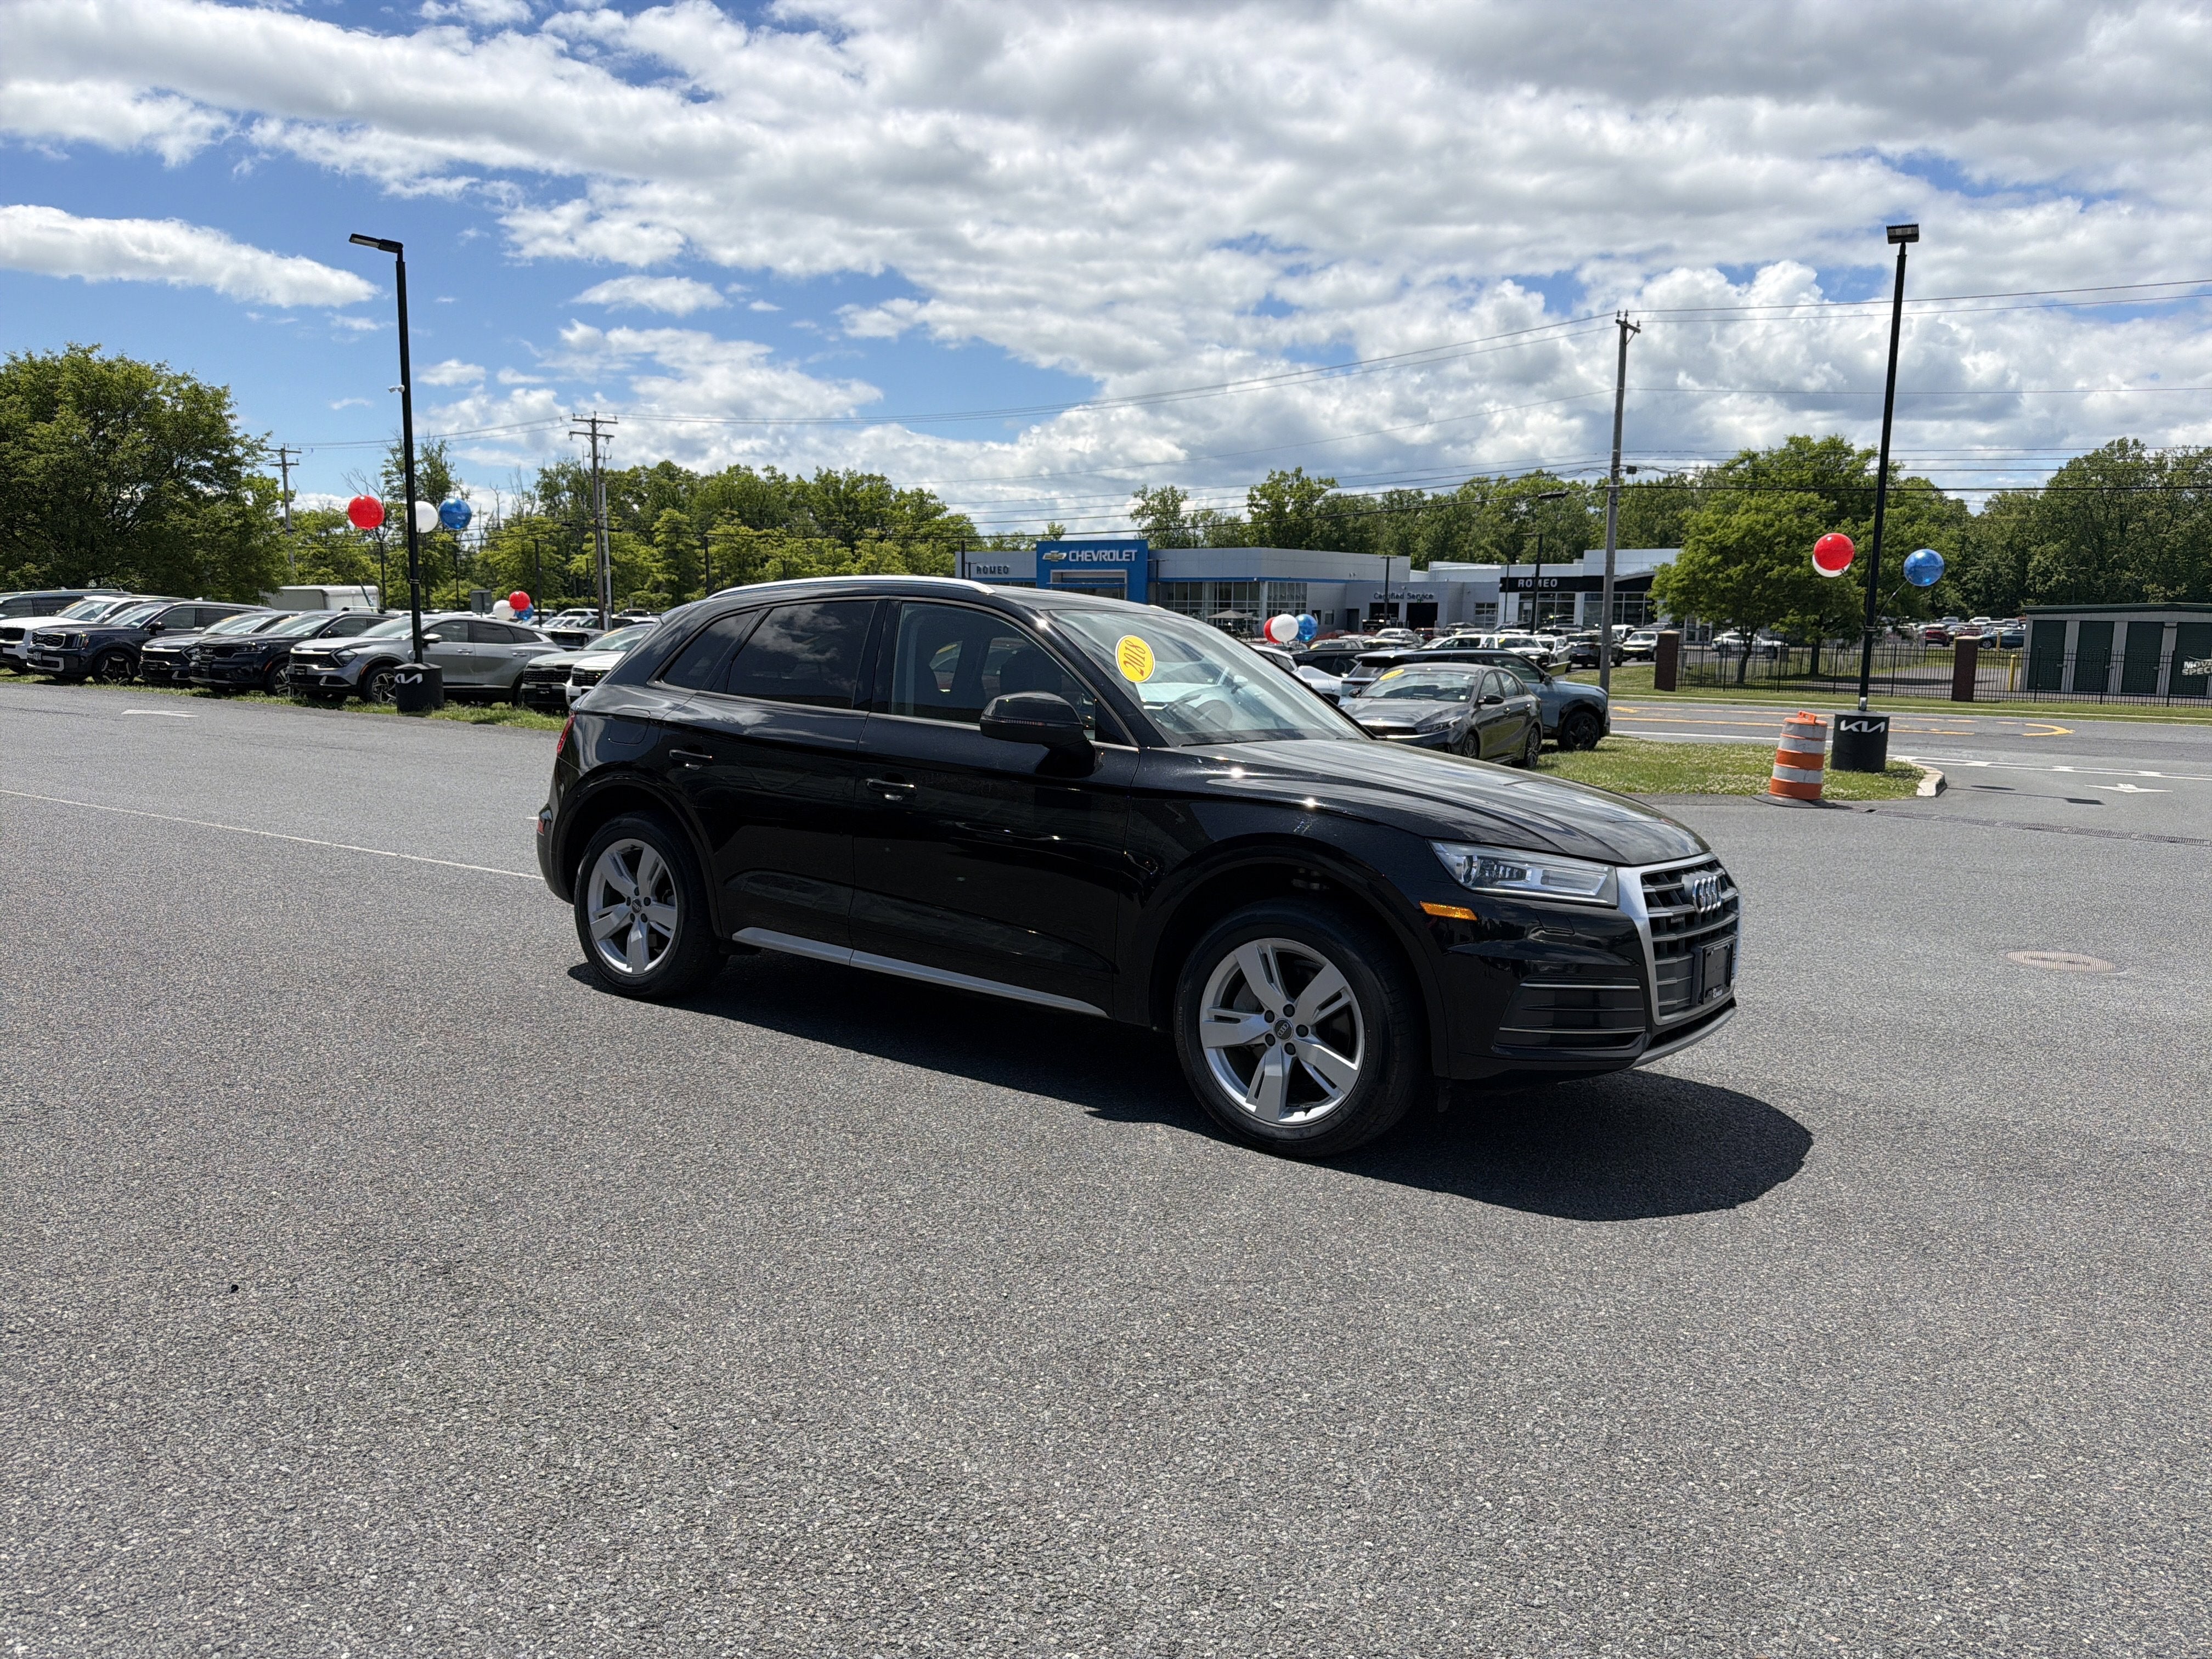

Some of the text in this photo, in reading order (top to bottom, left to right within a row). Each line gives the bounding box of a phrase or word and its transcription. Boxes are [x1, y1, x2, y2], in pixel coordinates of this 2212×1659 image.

[1069, 550, 1137, 562] CHEVROLET
[977, 566, 1009, 574] ROMEO
[1123, 640, 1146, 677] 2018
[2182, 666, 2212, 676] SPEC
[1839, 719, 1886, 733] KIA
